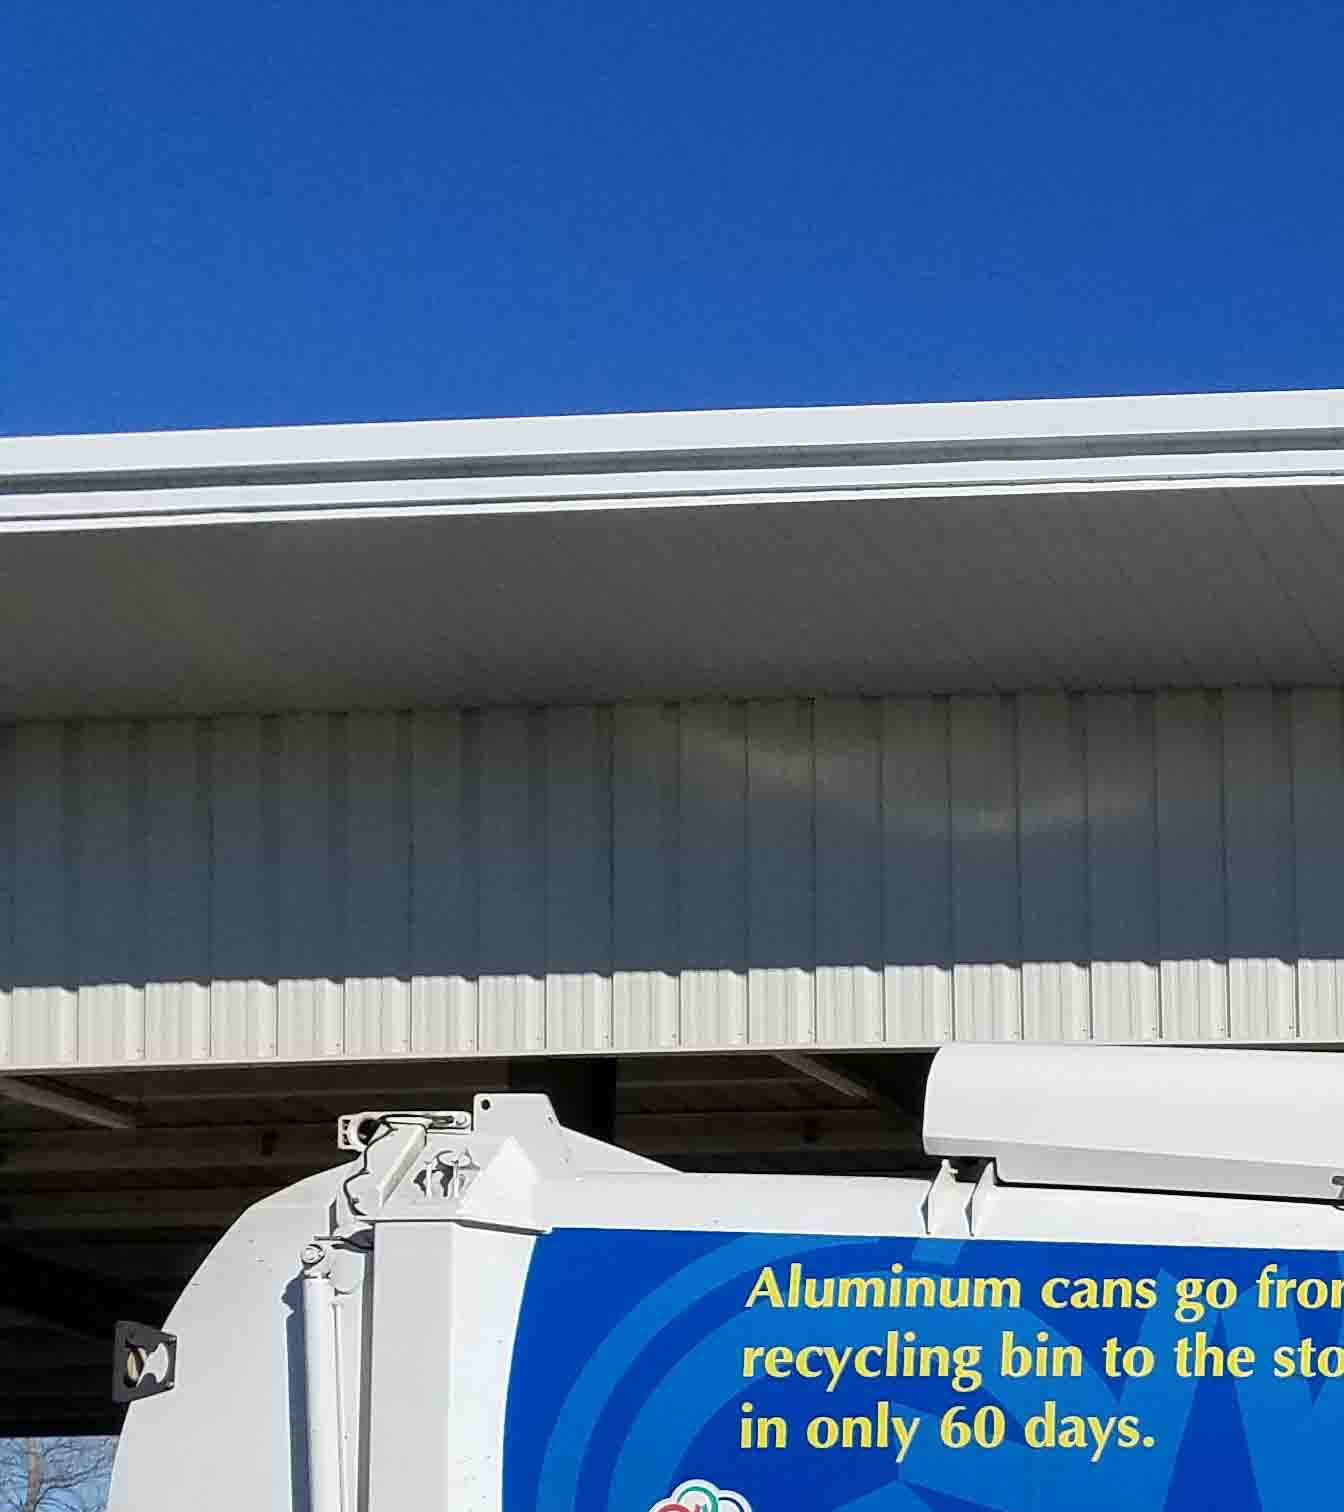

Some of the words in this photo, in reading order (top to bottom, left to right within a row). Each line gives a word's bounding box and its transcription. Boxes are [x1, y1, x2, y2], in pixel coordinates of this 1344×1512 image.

[744, 1263, 1021, 1308] Aluminum
[1040, 1276, 1158, 1309] cans
[1174, 1277, 1238, 1323] go
[741, 1330, 984, 1393] recycling
[1000, 1330, 1083, 1378] bin
[1102, 1336, 1156, 1378] to
[1173, 1331, 1256, 1378] the
[739, 1401, 788, 1449] in
[805, 1400, 921, 1463] only
[939, 1404, 1007, 1449] 60
[1024, 1400, 1156, 1463] days.
